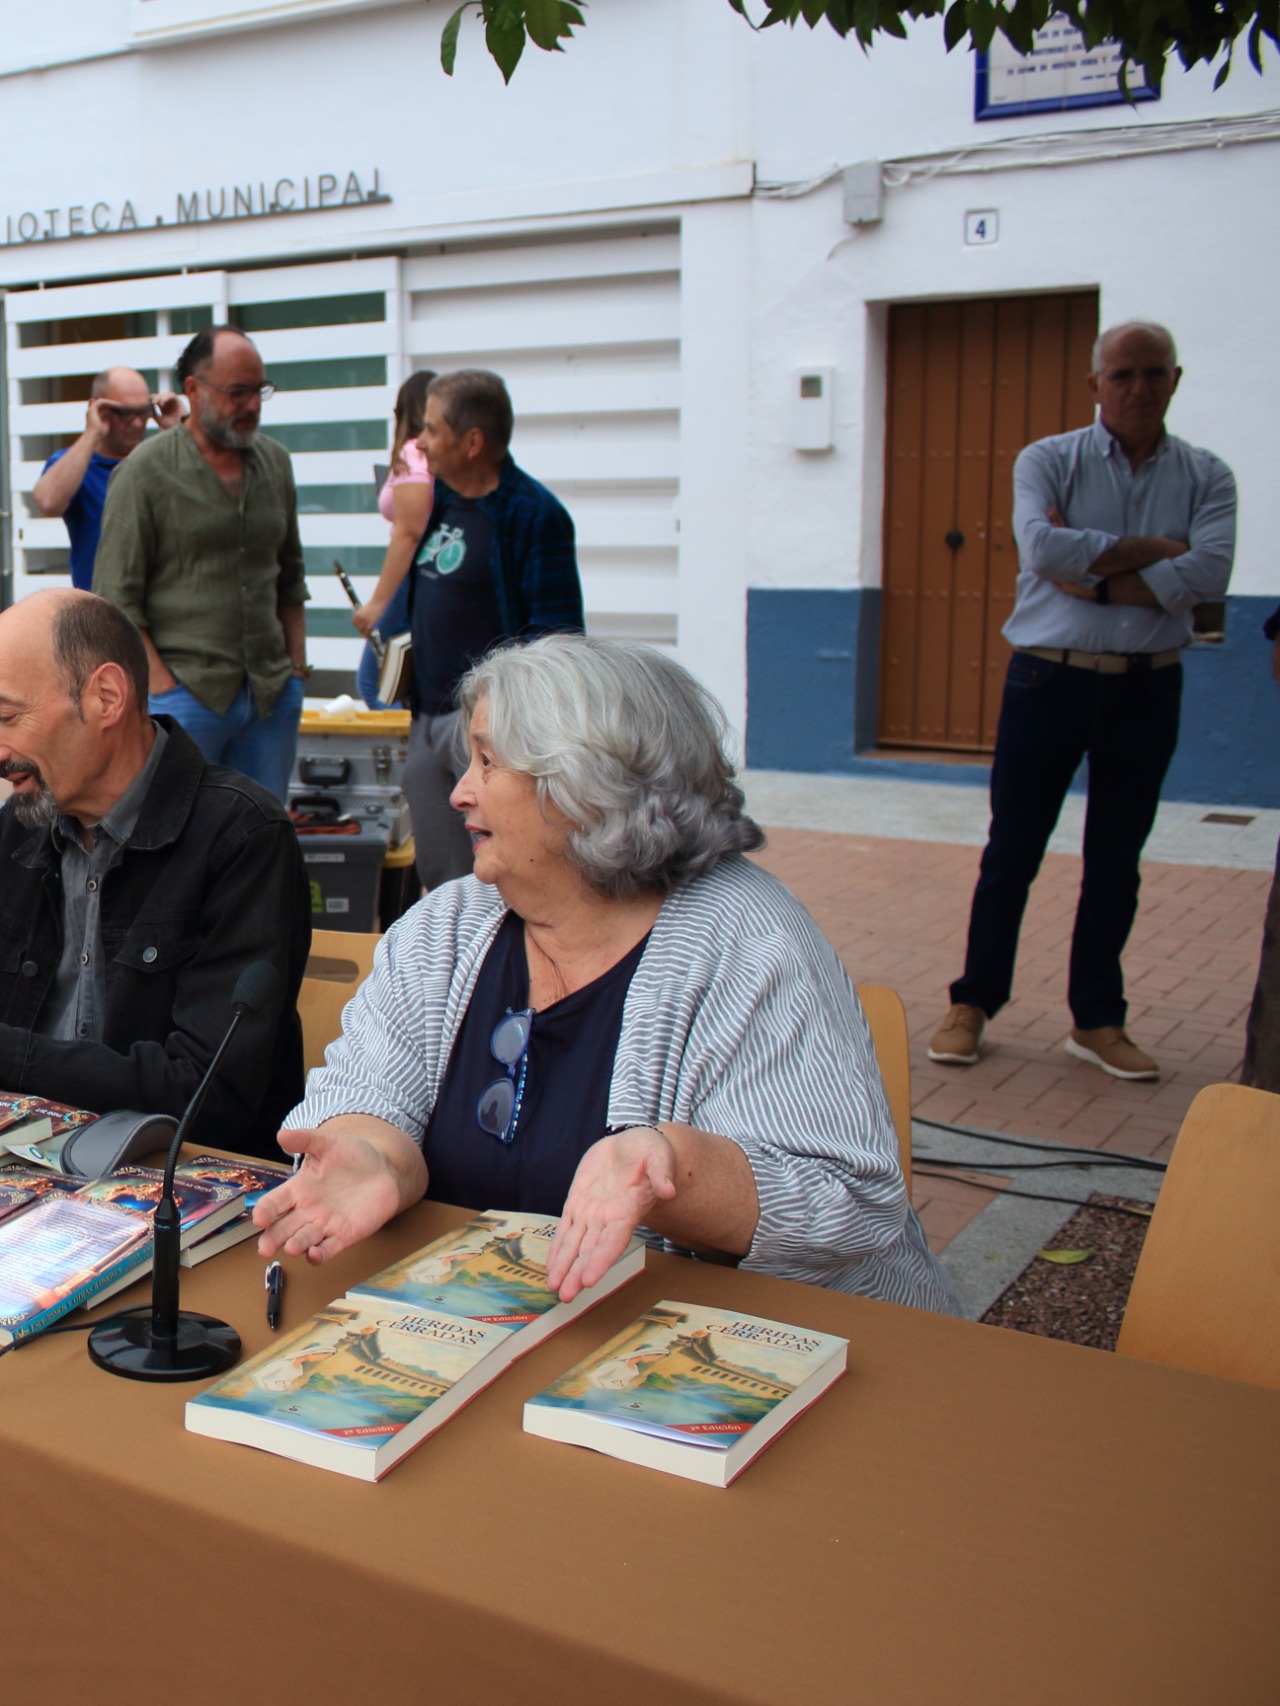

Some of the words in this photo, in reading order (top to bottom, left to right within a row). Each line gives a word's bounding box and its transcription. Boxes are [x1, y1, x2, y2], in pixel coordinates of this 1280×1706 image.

[177, 168, 388, 225] MUNICIPAL
[975, 219, 986, 239] 4
[402, 1315, 486, 1338] HERIDAS
[492, 1313, 528, 1323] Edición
[376, 1319, 479, 1345] CERRADAS
[706, 1324, 814, 1352] CERRADAS
[732, 1321, 822, 1347] HERIDAS
[355, 1425, 394, 1435] Edición
[702, 1423, 741, 1432] Edición
